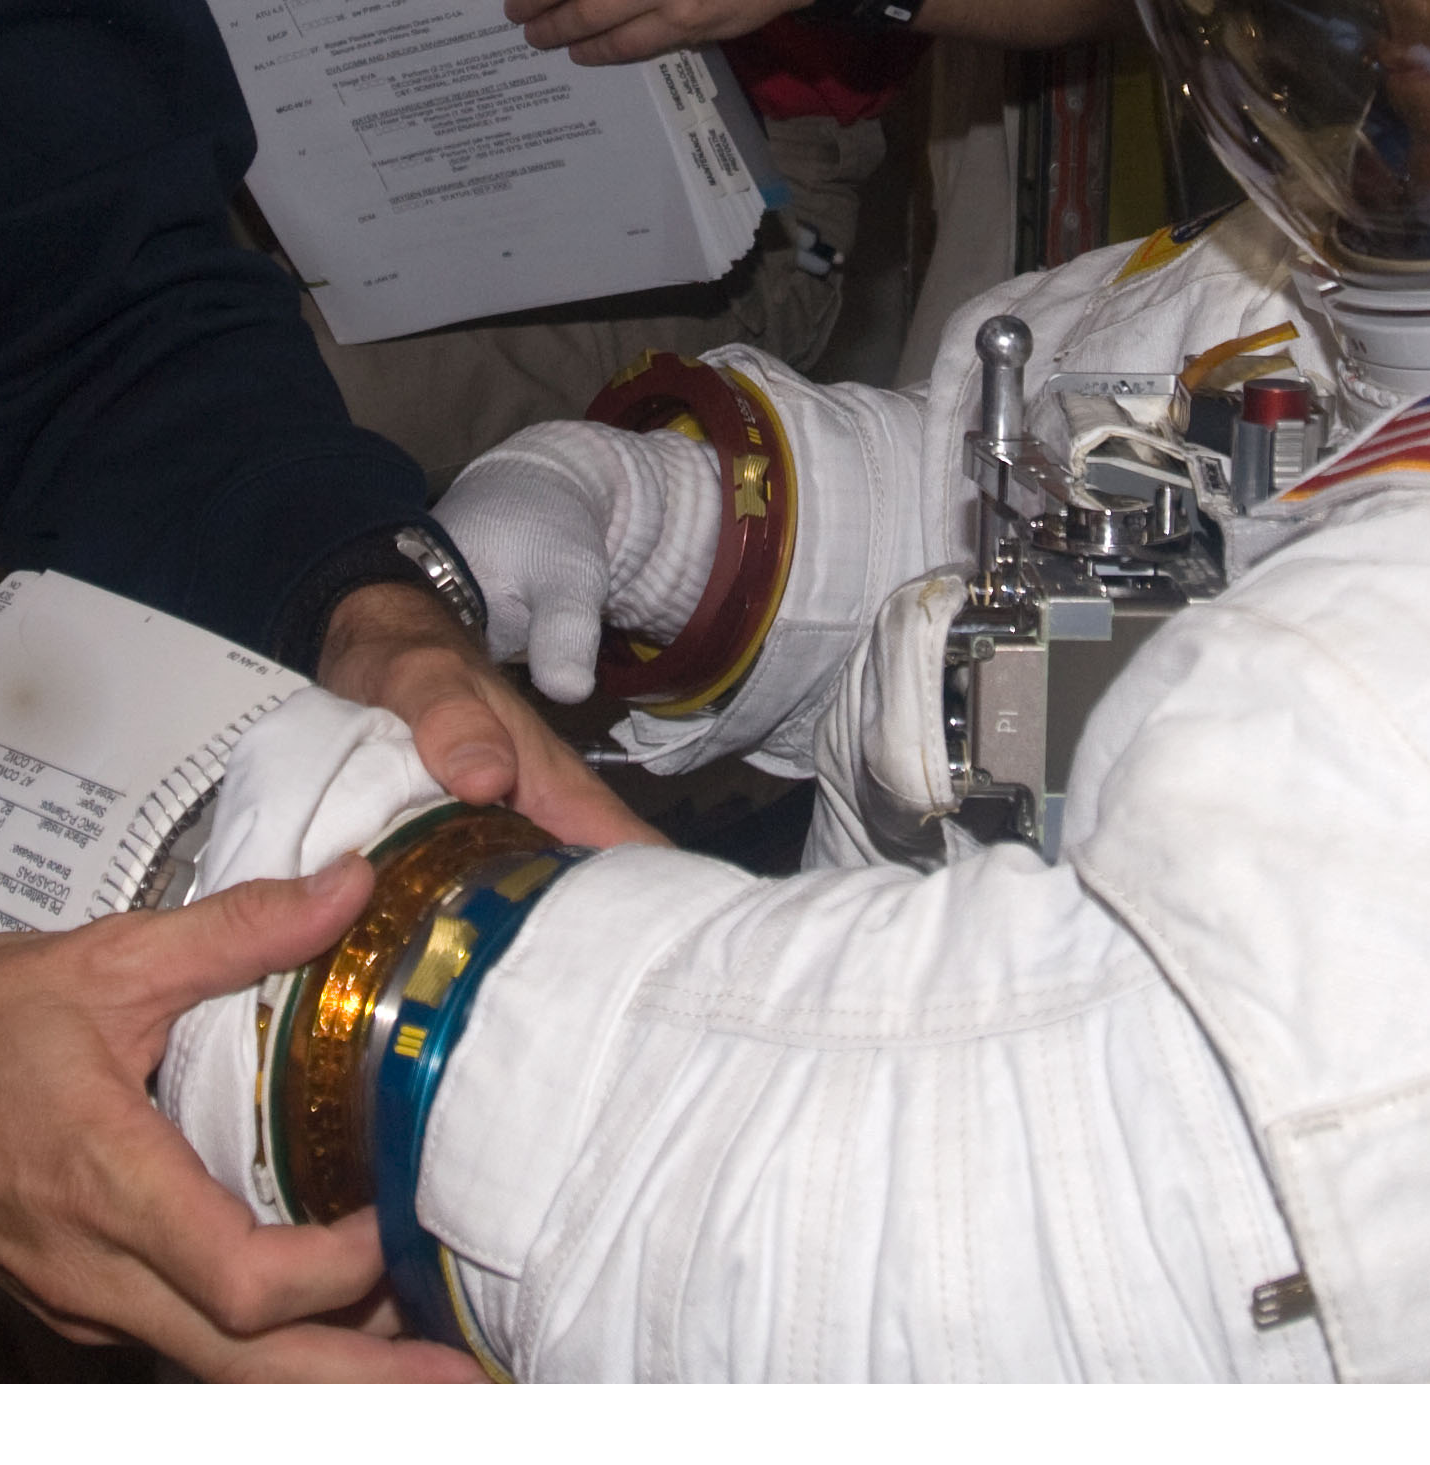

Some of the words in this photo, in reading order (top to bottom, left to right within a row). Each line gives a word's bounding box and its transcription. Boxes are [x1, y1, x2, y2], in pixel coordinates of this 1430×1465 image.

[659, 63, 685, 111] CHECKOUTS
[689, 131, 717, 186] MAINTENANCE
[238, 656, 259, 668] JAN
[93, 786, 117, 805] Hose
[75, 815, 105, 837] FHRC
[61, 828, 89, 850] Brace
[43, 858, 72, 880] Brace
[13, 865, 72, 900] UCCAS/PAS
[16, 883, 50, 908] Battery
[46, 898, 64, 917] P6
